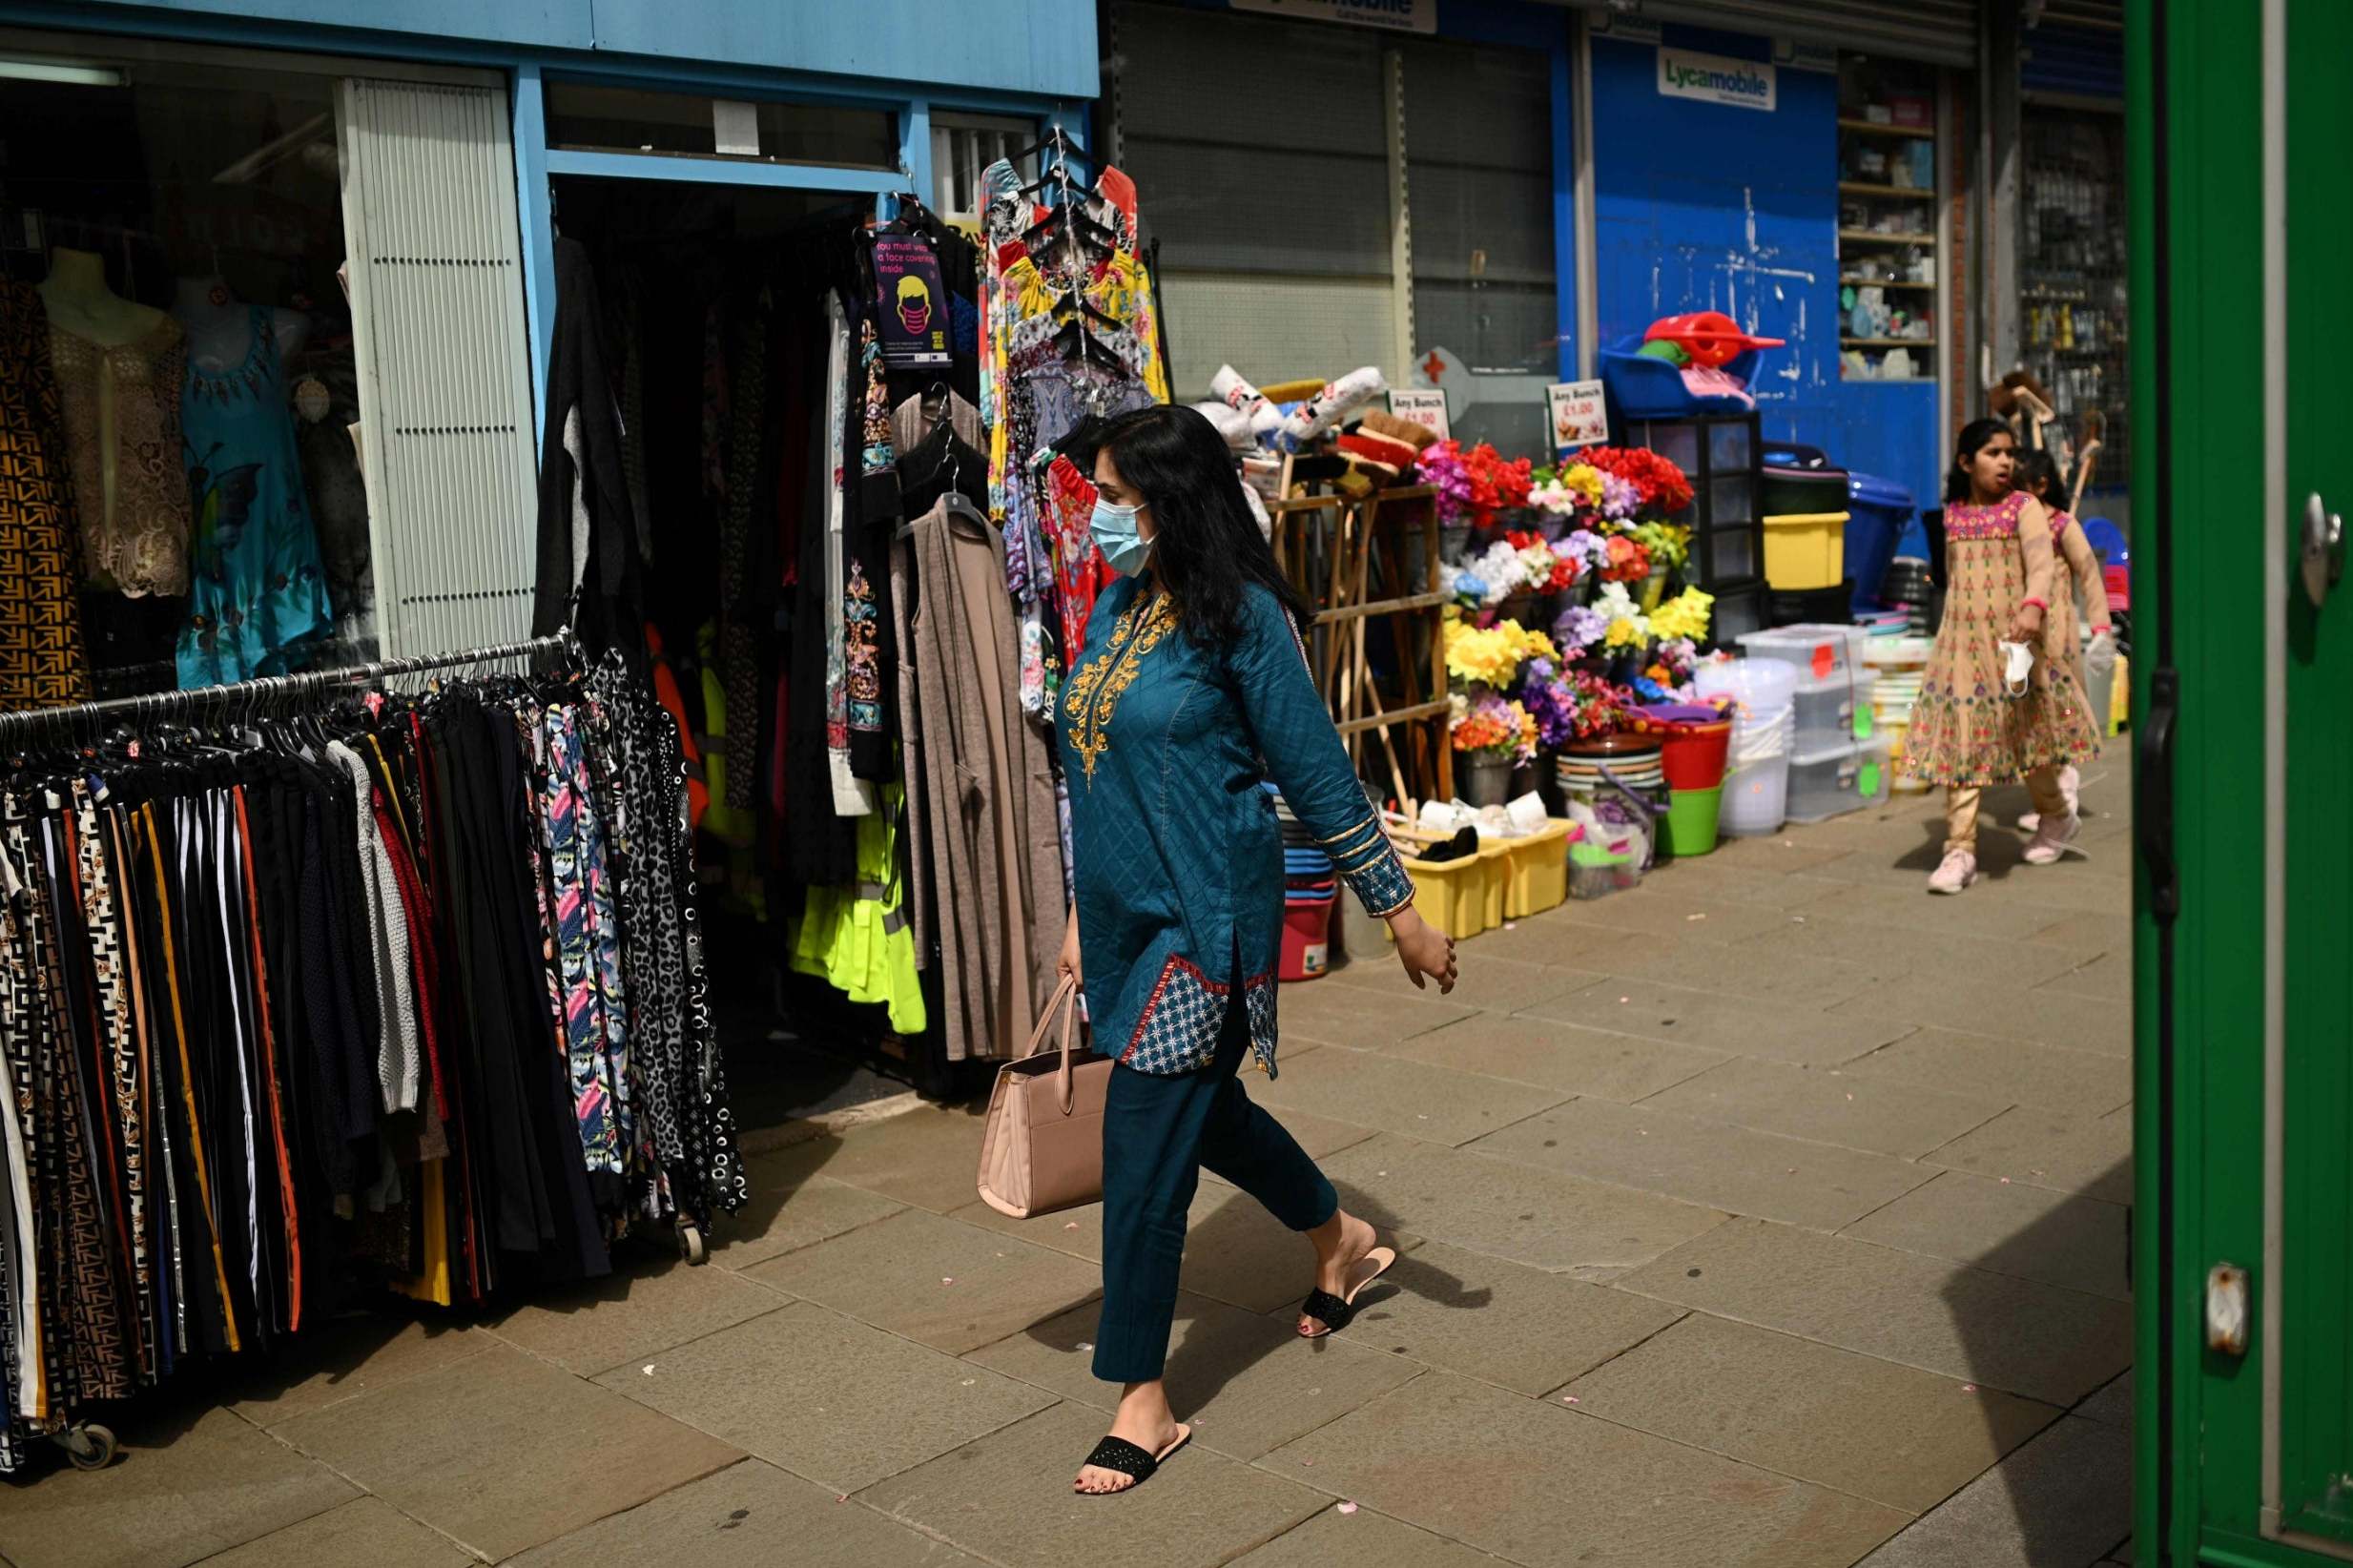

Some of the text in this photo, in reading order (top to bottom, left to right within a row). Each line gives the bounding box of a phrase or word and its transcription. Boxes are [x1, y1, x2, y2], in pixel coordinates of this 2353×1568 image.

[1665, 58, 1768, 96] Lycamobile
[885, 252, 904, 261] face
[879, 264, 904, 274] inside
[1555, 387, 1601, 402] Any Bunch
[1394, 396, 1443, 409] Any Bunch
